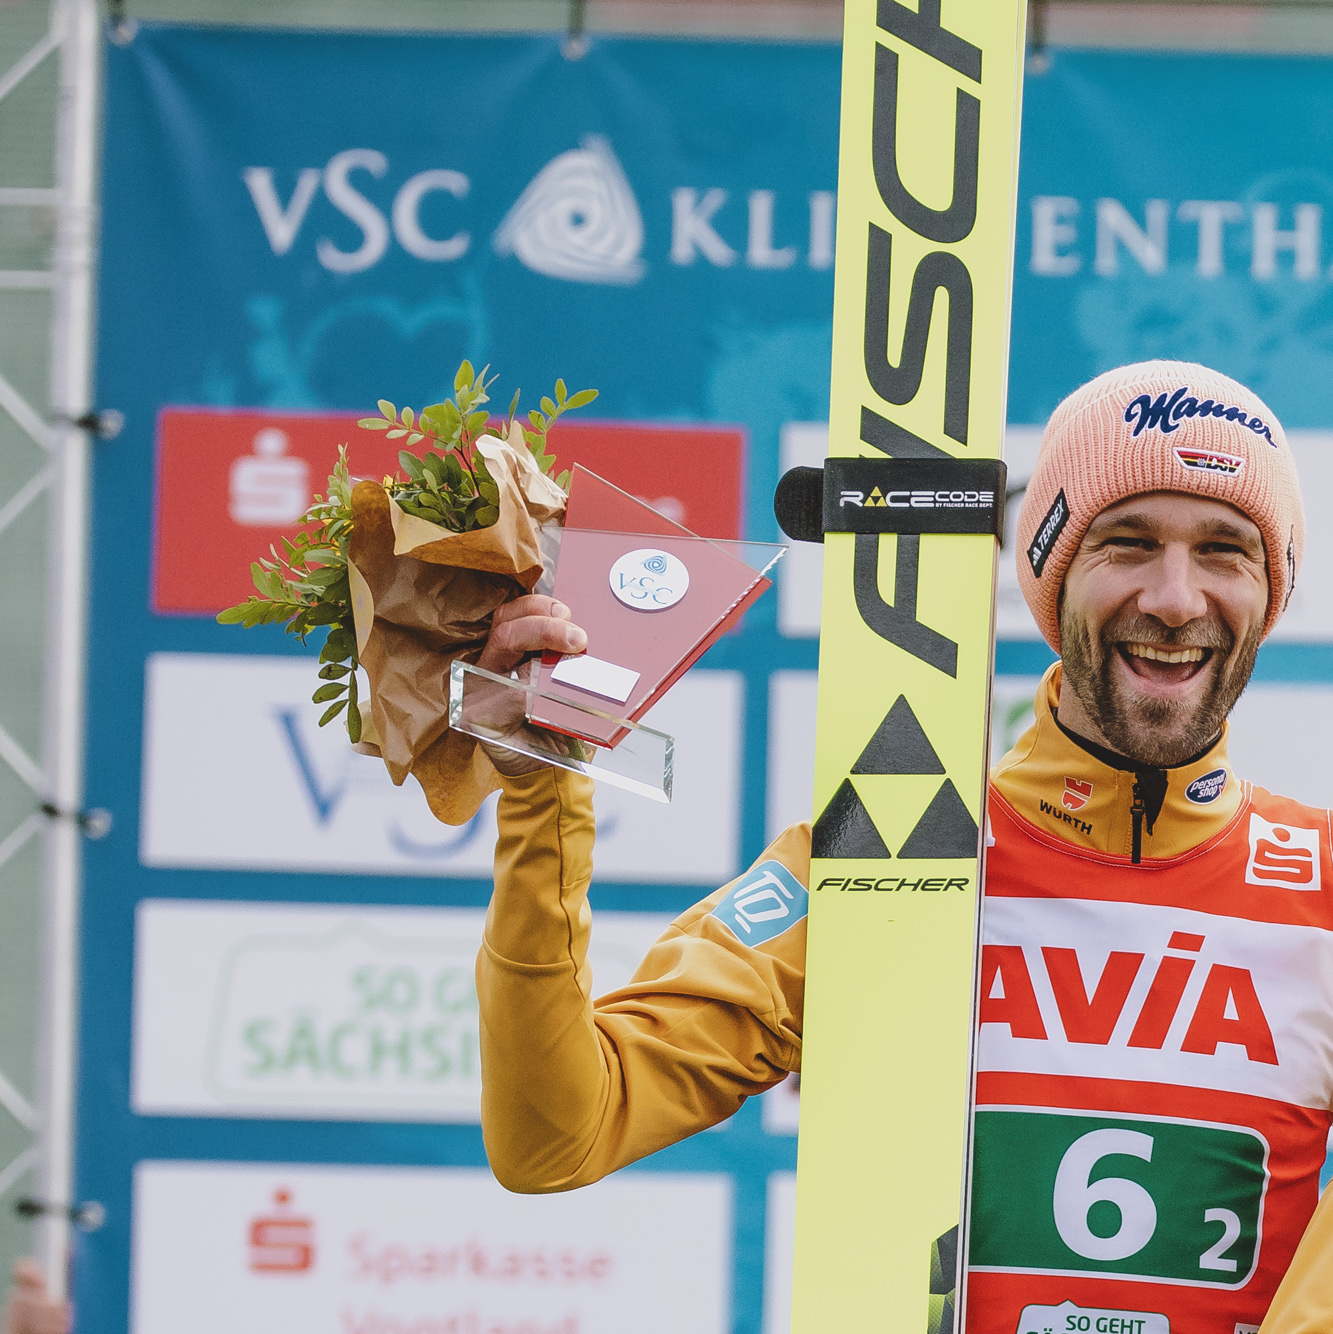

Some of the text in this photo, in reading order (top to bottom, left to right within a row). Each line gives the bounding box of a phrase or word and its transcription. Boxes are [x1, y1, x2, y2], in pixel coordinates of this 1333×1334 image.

[243, 148, 471, 274] VSC
[1124, 387, 1277, 447] Manner
[1210, 456, 1239, 473] DSV
[1038, 499, 1065, 551] TERREX
[619, 572, 673, 605] VSC
[1190, 770, 1225, 796] personal
[1198, 782, 1219, 799] shop
[815, 876, 970, 893] FISCHER
[1052, 1128, 1241, 1272] 6 2
[346, 1227, 616, 1284] Sparkasse
[1065, 1314, 1091, 1332] SO
